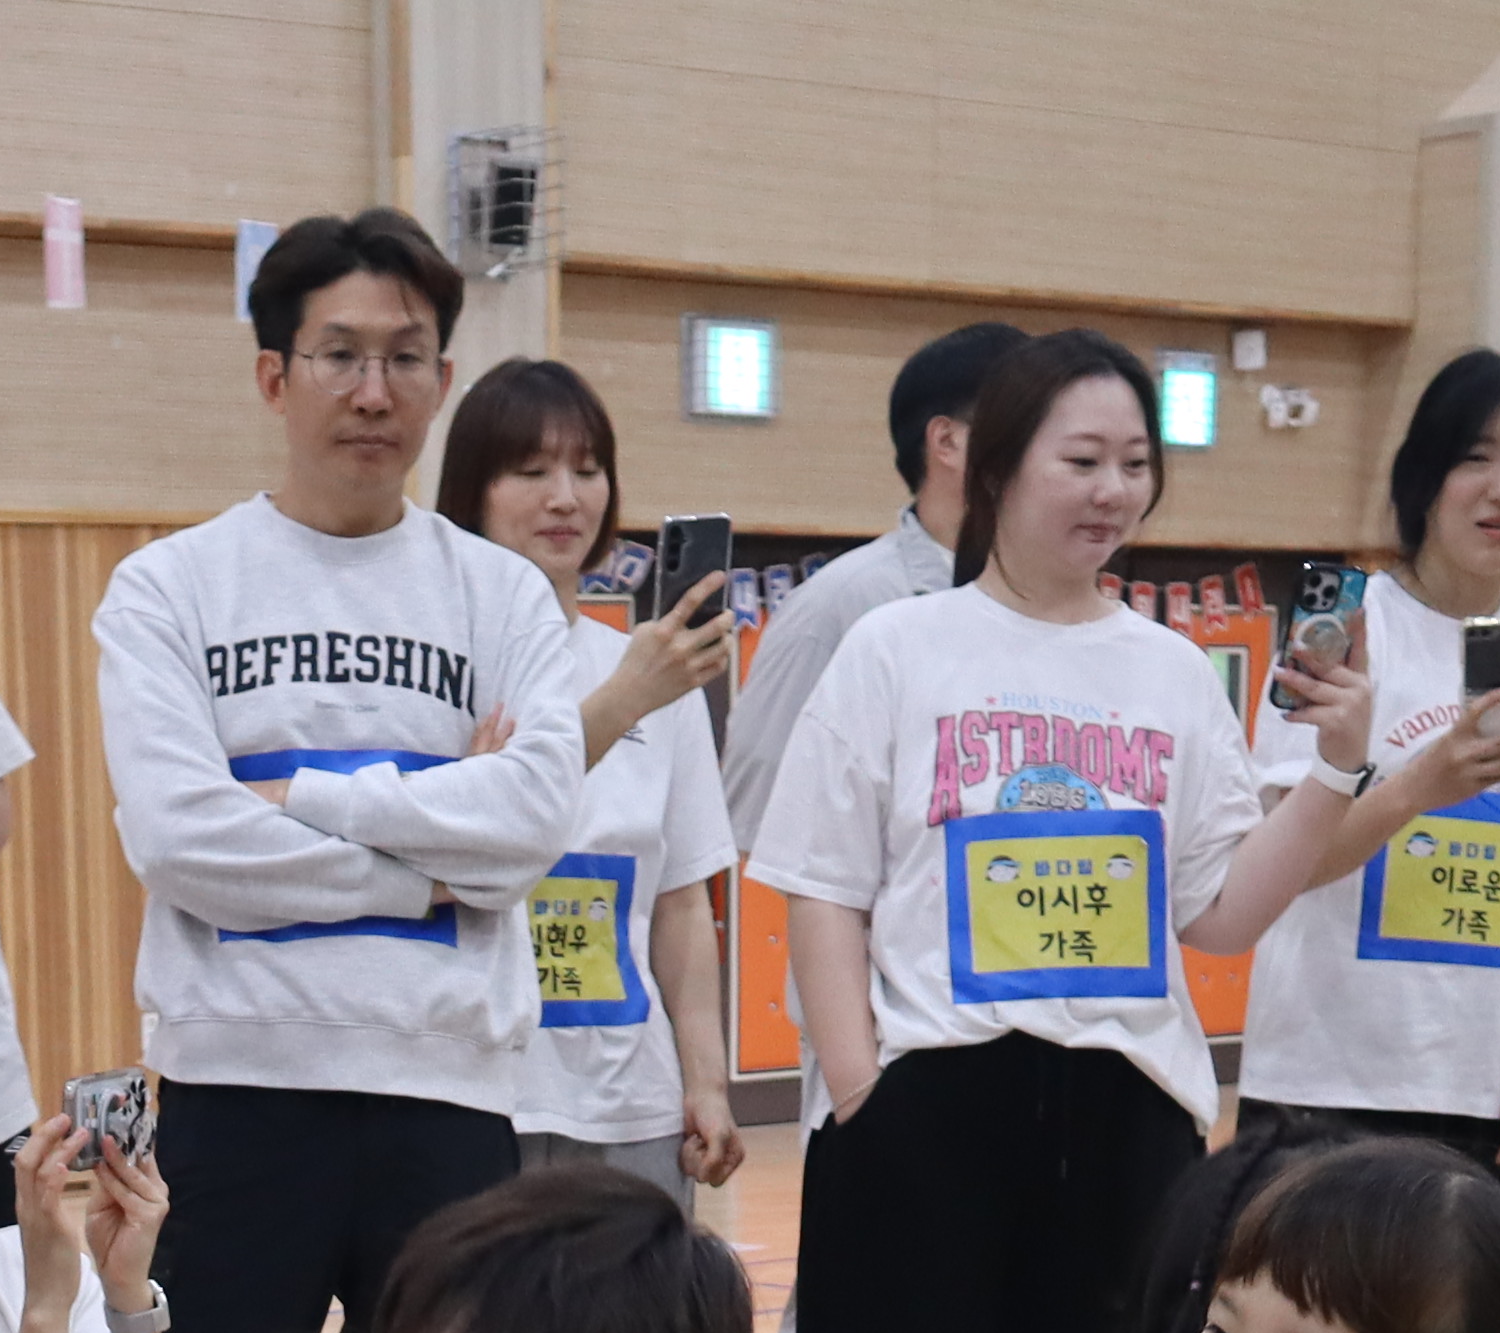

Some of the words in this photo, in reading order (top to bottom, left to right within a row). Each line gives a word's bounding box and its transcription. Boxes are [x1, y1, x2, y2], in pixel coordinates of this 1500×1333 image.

[205, 630, 476, 718] REFRESHIN
[1001, 691, 1104, 721] HOUSTON
[1016, 883, 1113, 917] 이시후
[1440, 907, 1491, 942] 가족
[1038, 930, 1098, 964] 가족
[536, 965, 583, 998] 가족
